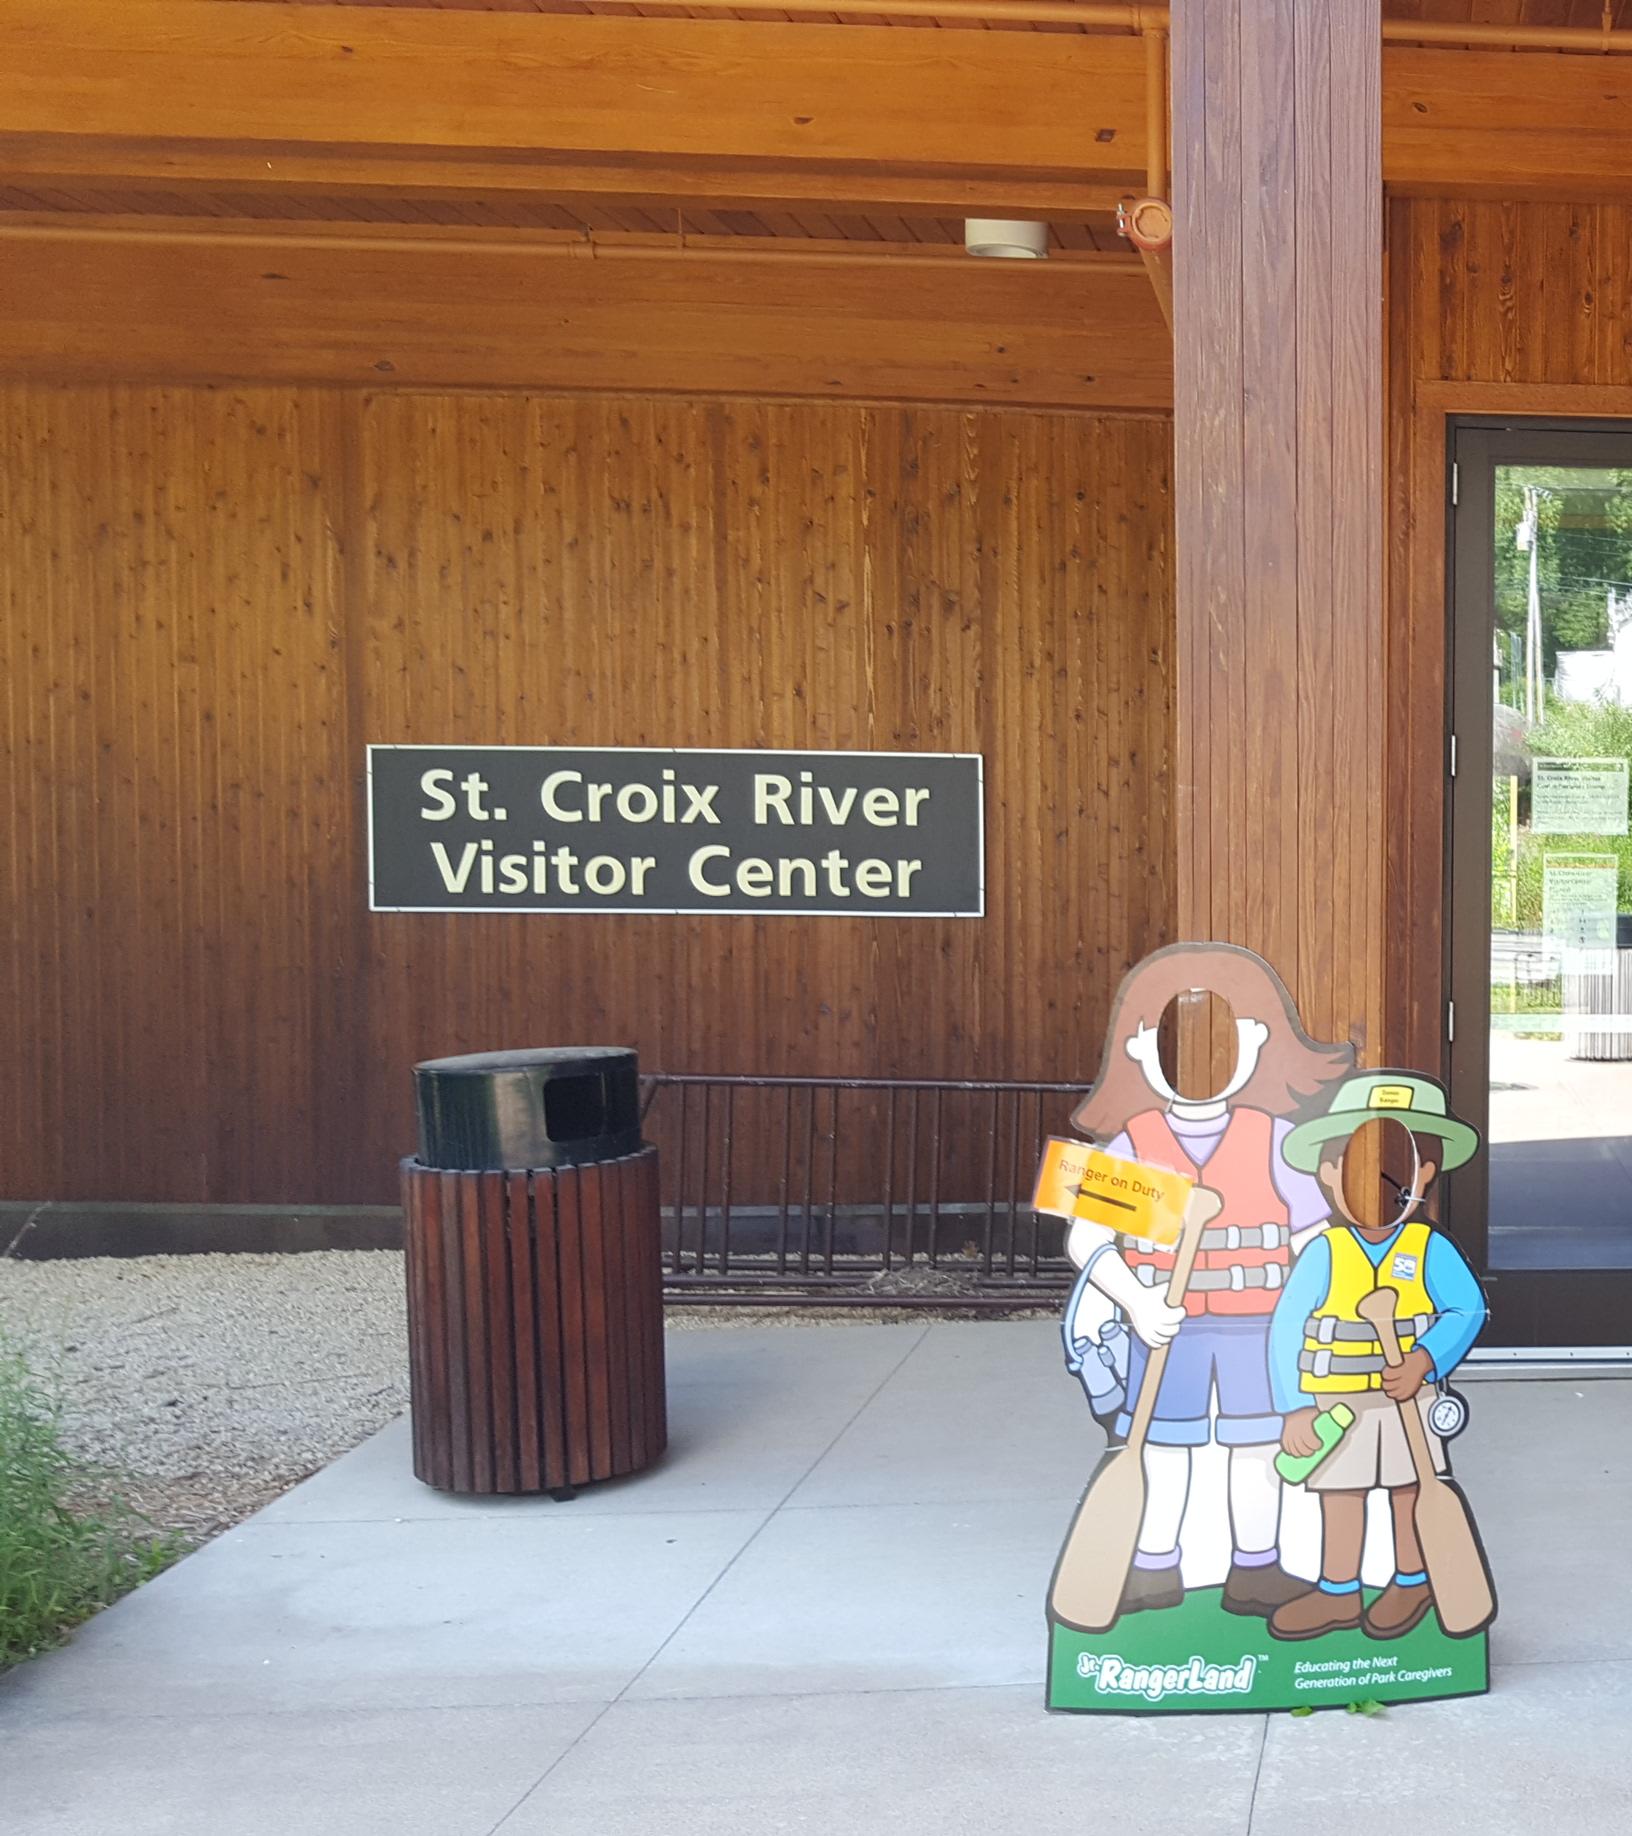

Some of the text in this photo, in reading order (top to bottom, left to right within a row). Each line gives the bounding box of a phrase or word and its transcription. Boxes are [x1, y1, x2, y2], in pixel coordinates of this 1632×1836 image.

[419, 768, 931, 828] St. Croix River
[429, 840, 922, 898] Visitor Center
[1059, 1159, 1166, 1202] Ranger on Duty
[1098, 1657, 1254, 1698] RangerLand
[1294, 1655, 1398, 1674] Educating the Next
[1294, 1666, 1453, 1690] Generation of Park Caregivers
